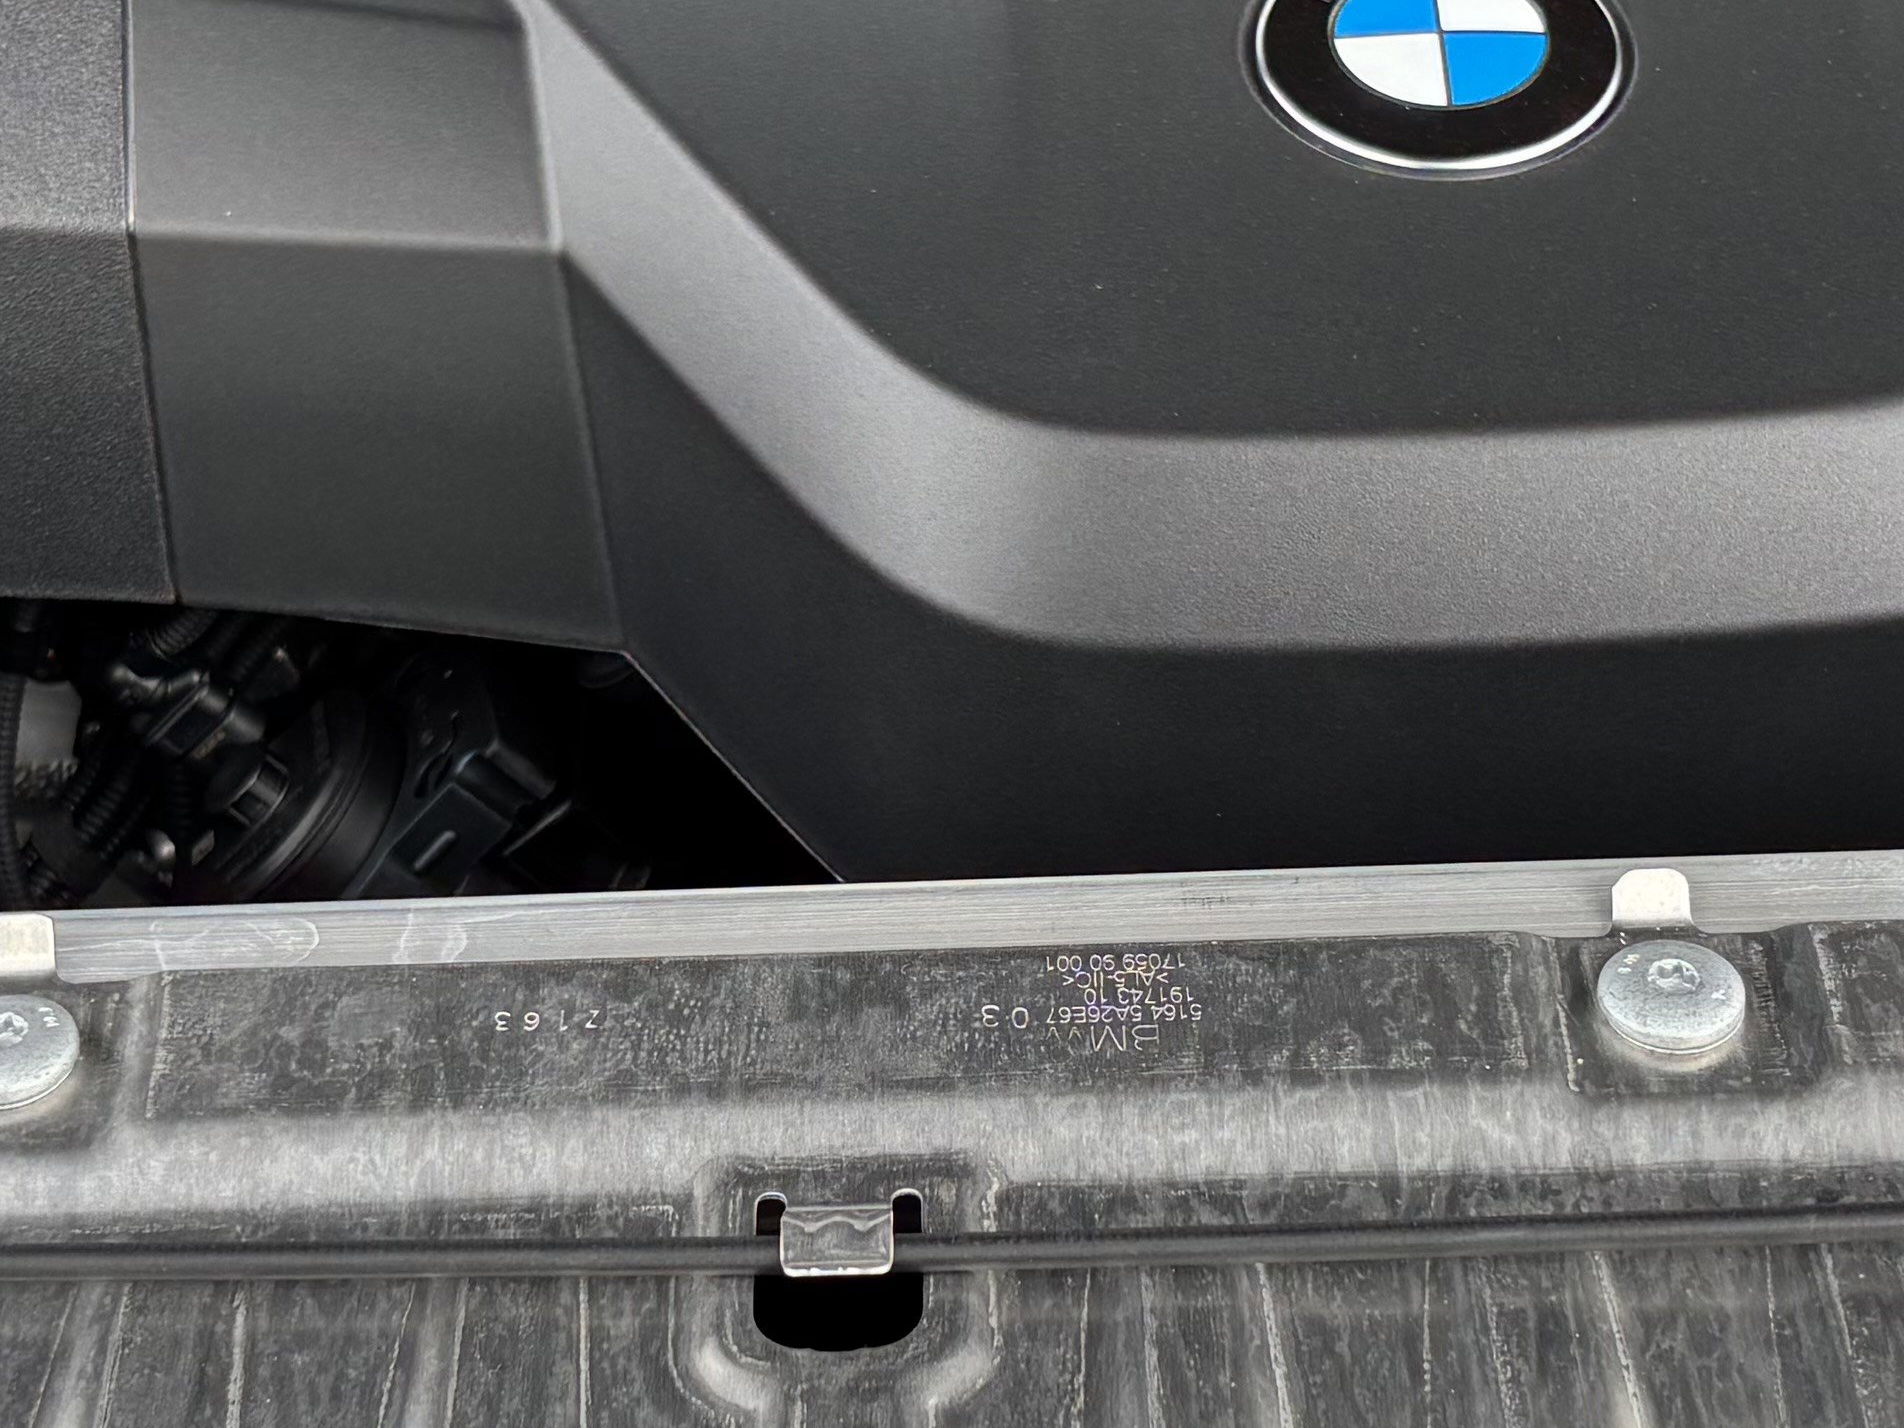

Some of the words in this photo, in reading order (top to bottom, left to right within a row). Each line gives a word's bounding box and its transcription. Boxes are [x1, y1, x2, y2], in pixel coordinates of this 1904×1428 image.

[1045, 954, 1083, 972] 001
[1089, 954, 1115, 971] 90
[1116, 986, 1195, 1004] 191743
[1045, 1004, 1142, 1024] 5A26E67
[1150, 1003, 1202, 1021] 5164
